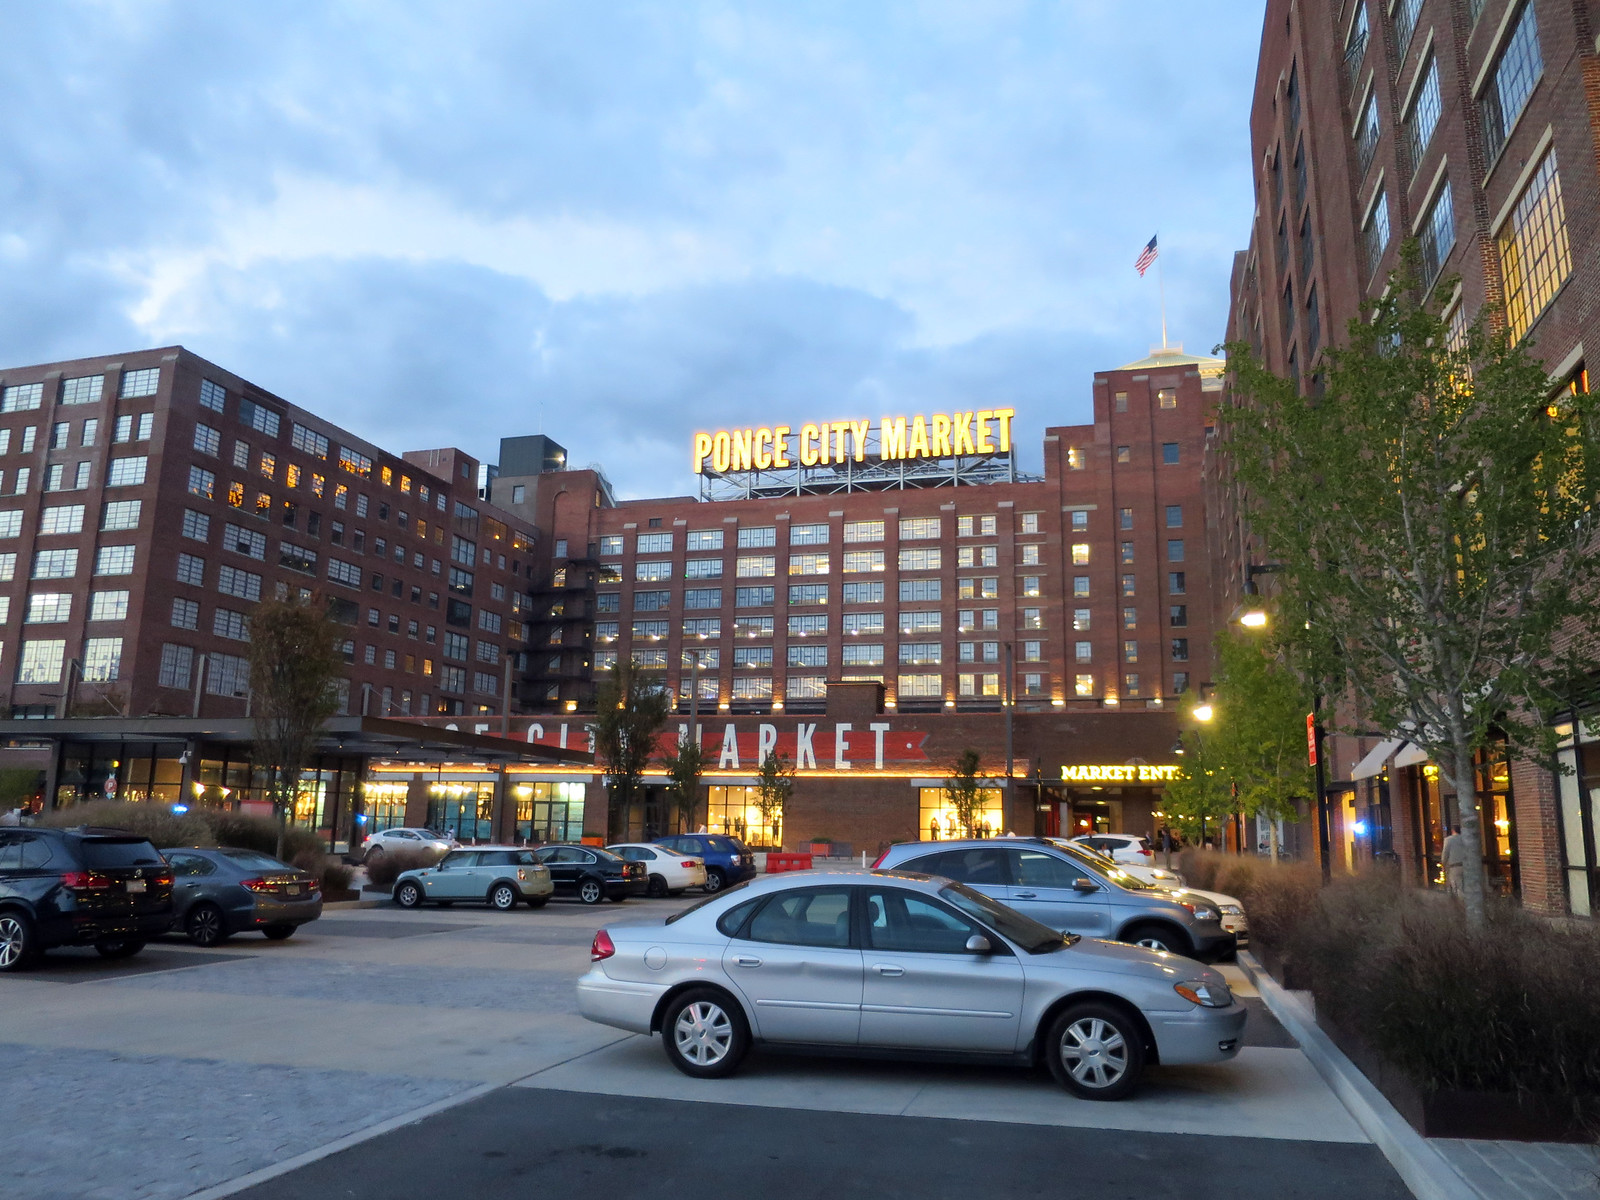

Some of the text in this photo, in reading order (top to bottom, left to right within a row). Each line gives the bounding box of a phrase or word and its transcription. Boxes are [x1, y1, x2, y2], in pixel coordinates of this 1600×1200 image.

[694, 408, 1014, 473] PONCE CITY MARKET
[1061, 765, 1136, 780] MARKET
